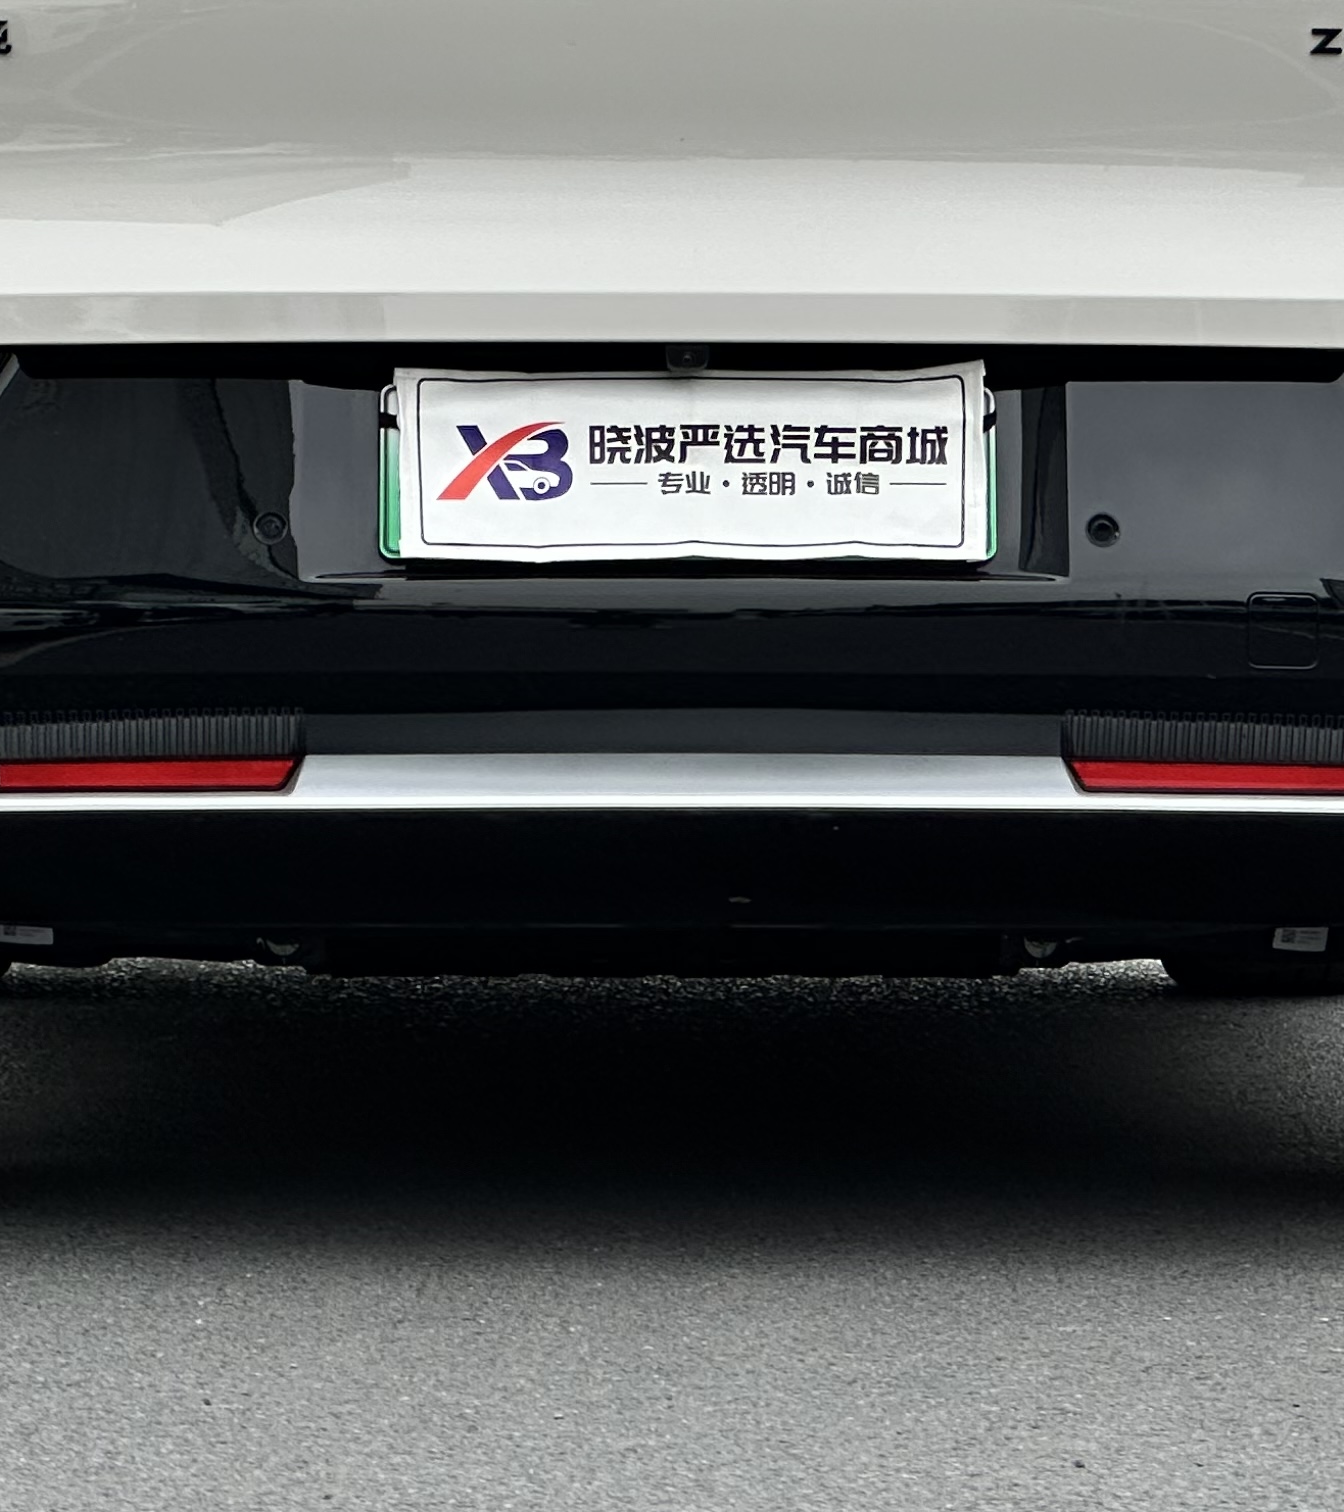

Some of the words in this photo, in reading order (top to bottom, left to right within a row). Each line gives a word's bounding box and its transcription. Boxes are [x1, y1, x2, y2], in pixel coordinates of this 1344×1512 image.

[588, 424, 949, 465] 晓波严选汽车商城
